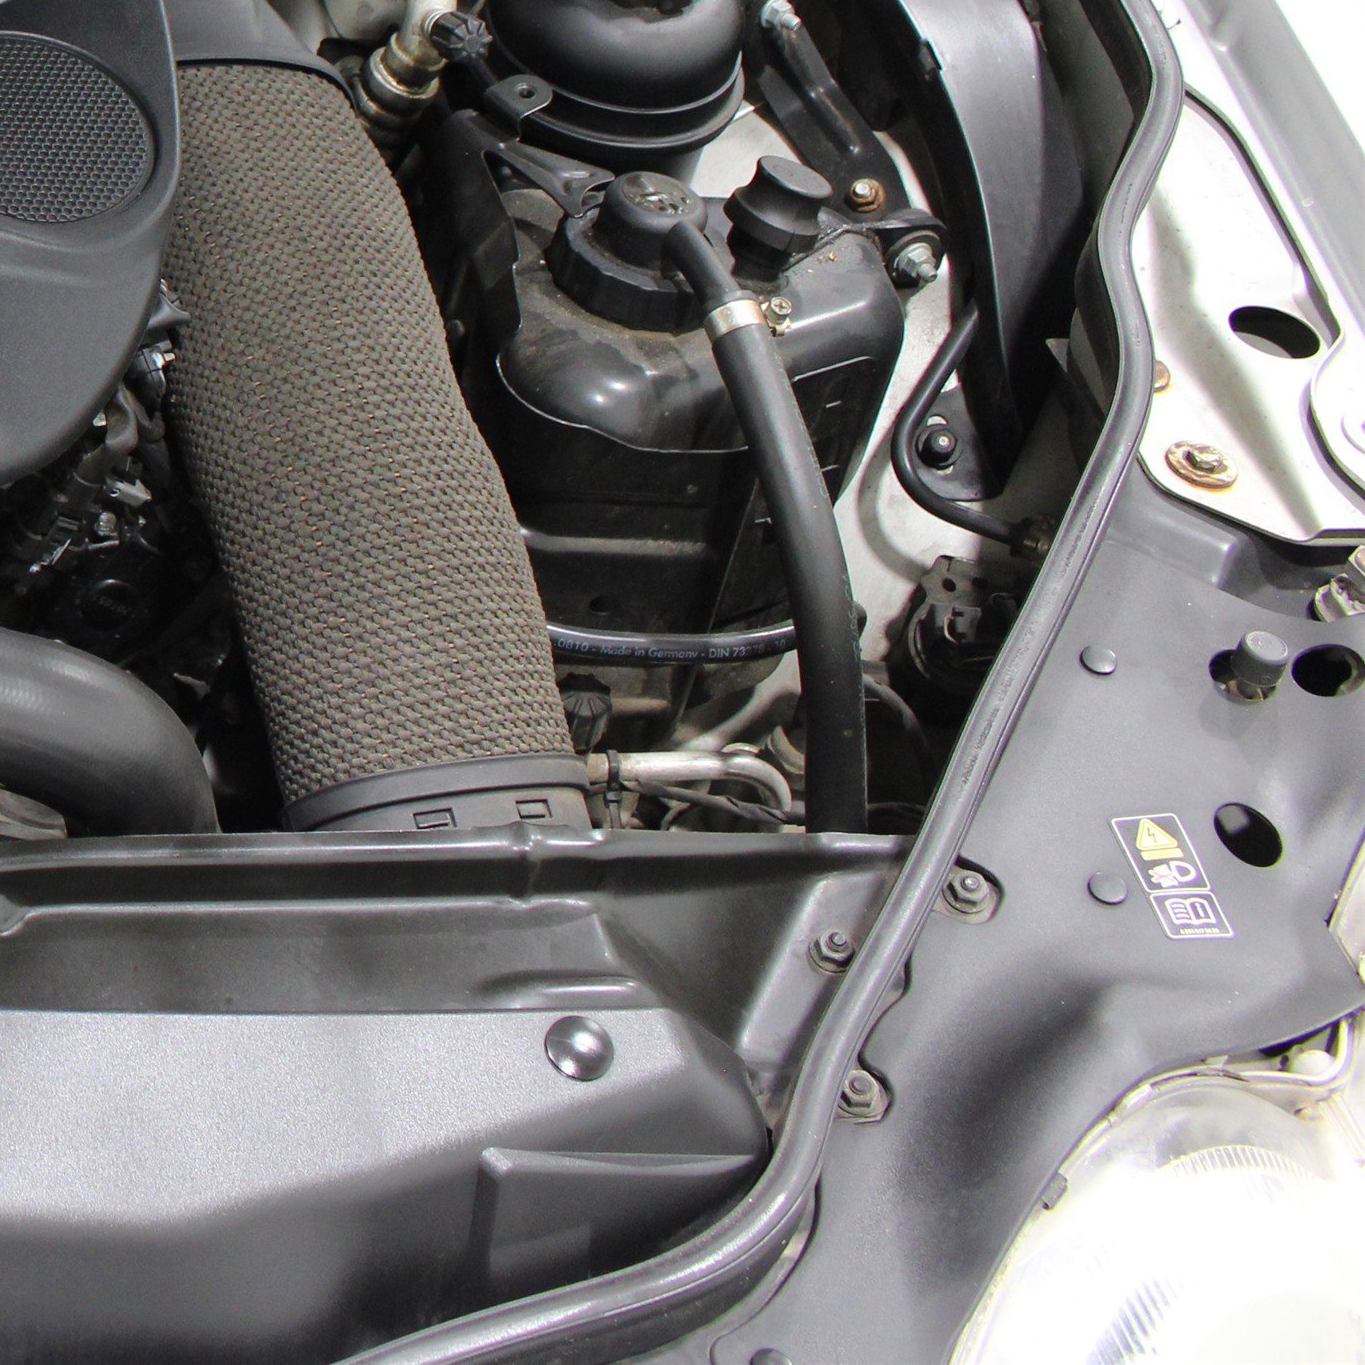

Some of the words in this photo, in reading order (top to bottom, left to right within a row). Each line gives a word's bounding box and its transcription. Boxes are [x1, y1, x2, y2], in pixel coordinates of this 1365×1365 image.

[635, 647, 646, 657] in
[648, 647, 698, 659] Germany
[708, 647, 731, 658] DIN
